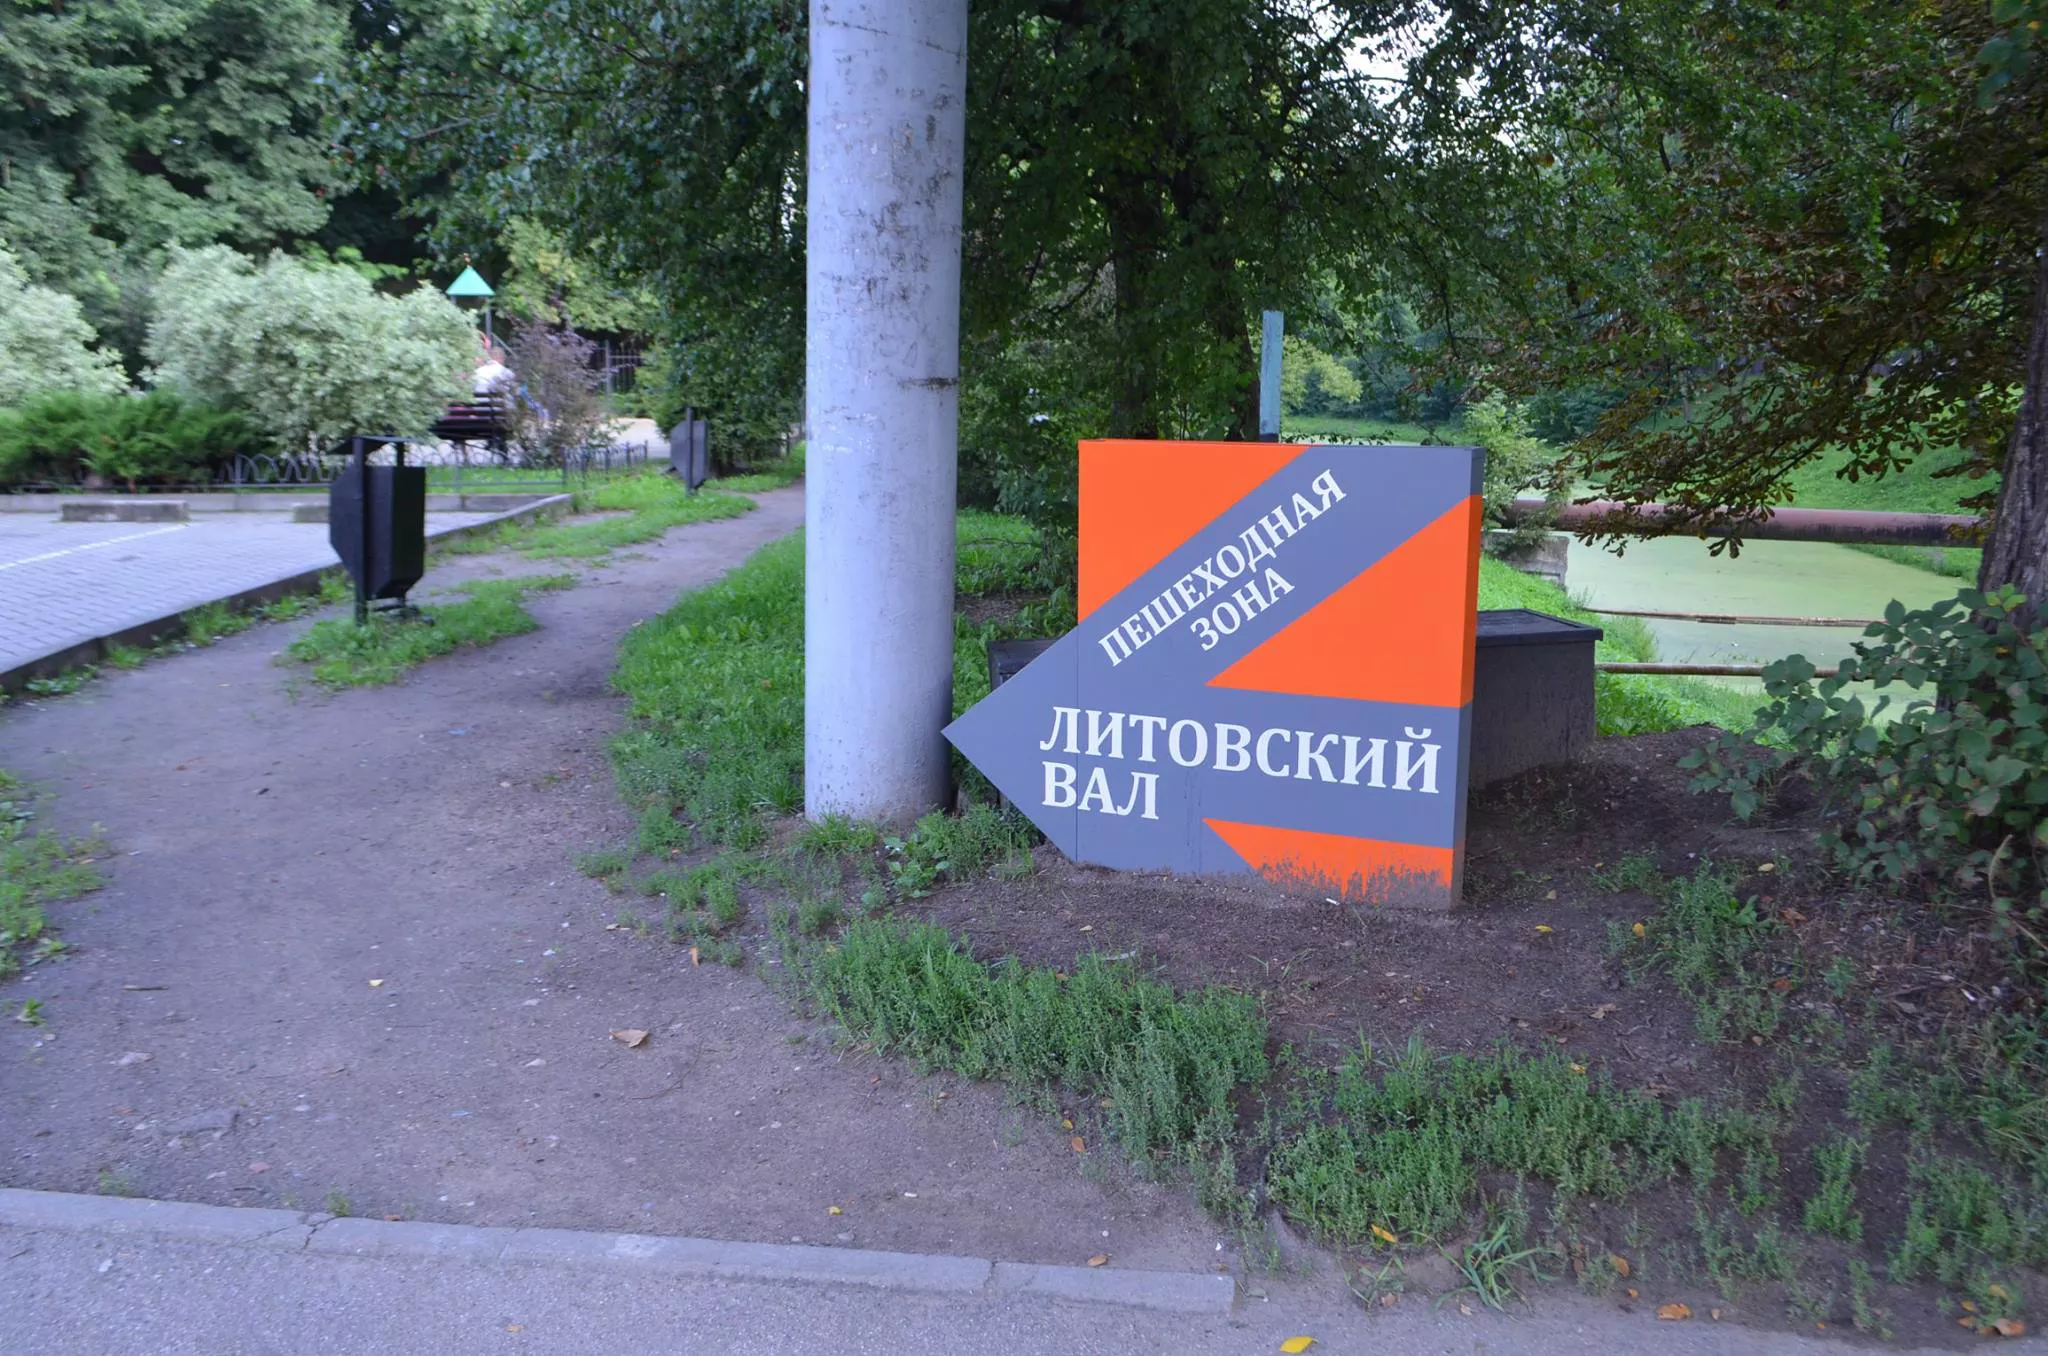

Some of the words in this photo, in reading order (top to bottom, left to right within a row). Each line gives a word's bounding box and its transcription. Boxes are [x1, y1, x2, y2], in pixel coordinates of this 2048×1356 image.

[1098, 469, 1347, 666] ПЕШЕХОДНАЯ
[1190, 568, 1295, 651] ЗОНА
[1040, 707, 1441, 793] ЛИТОВСКИЙ
[1042, 761, 1159, 819] ВАЛ
